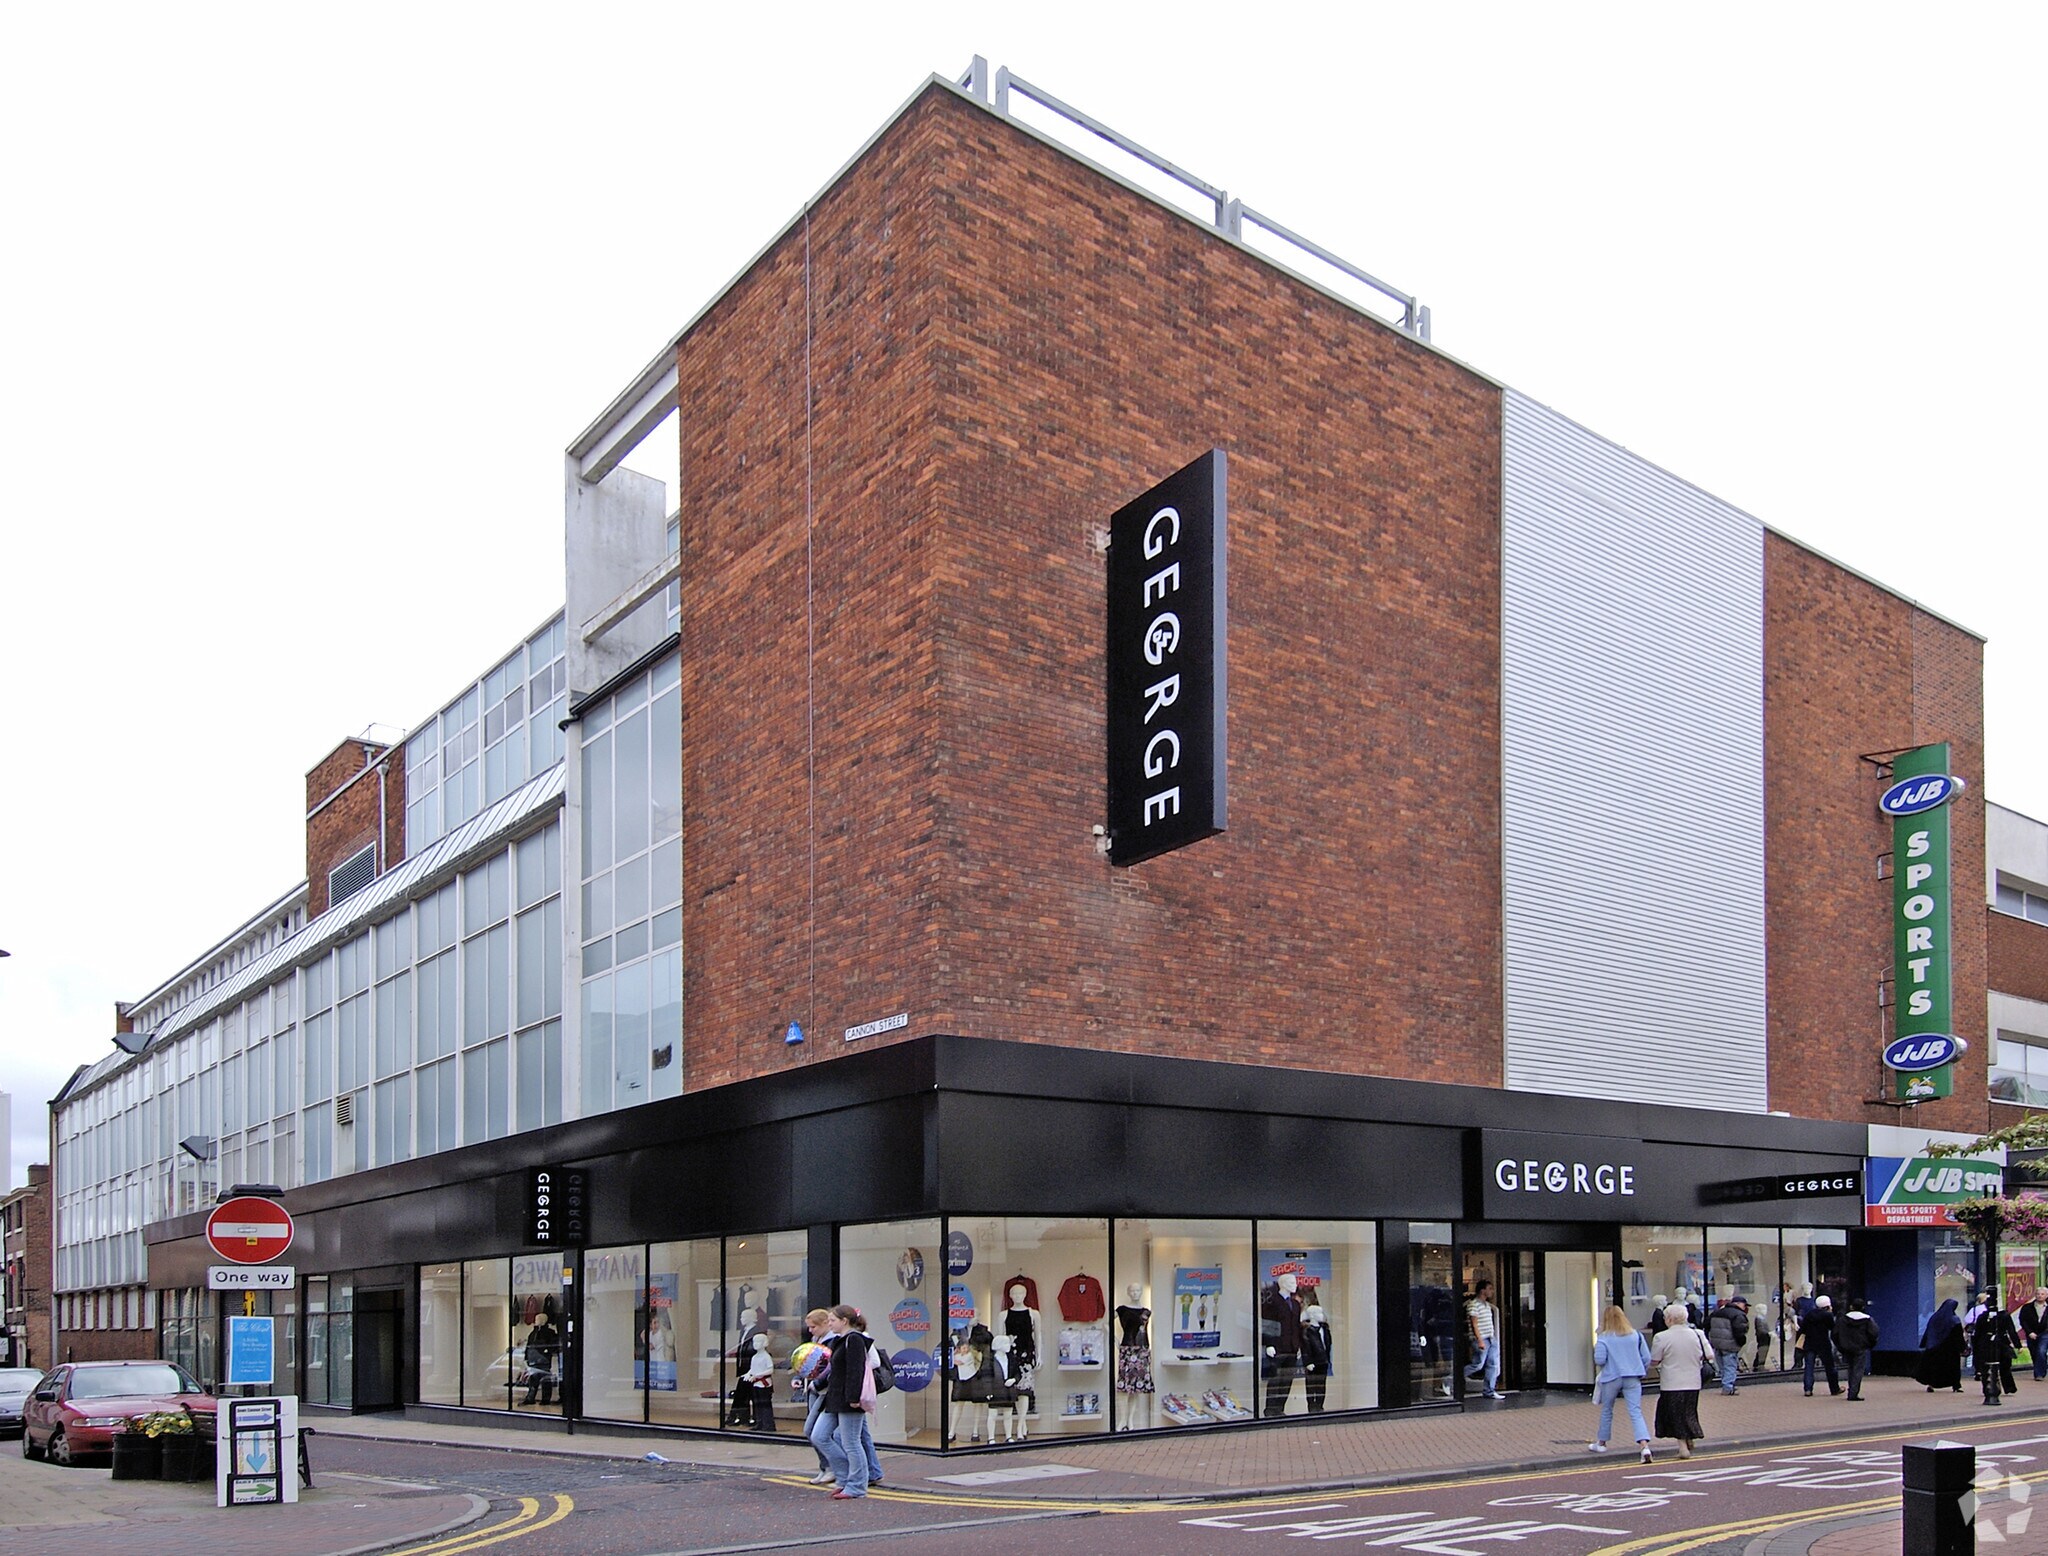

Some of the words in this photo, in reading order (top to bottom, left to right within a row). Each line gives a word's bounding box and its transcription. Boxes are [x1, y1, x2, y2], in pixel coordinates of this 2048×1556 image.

[1143, 506, 1181, 827] GEORGE
[1889, 779, 1945, 809] JJB
[1903, 831, 1935, 1016] SPORTS
[846, 1022, 876, 1039] CANNON
[879, 1014, 906, 1031] STREET
[1892, 1039, 1947, 1064] JJB
[1495, 1159, 1635, 1195] GEORGE
[1903, 1168, 1963, 1193] JJB
[1784, 1178, 1854, 1192] GEORGE
[537, 1172, 550, 1240] GEORGE
[1881, 1206, 1908, 1215] LADIES
[1910, 1206, 1937, 1215] SPORTS
[1886, 1215, 1934, 1224] DEPARTMENT
[948, 1258, 967, 1269] prima
[1271, 1263, 1297, 1276] BACK
[1298, 1265, 1305, 1274] 2
[215, 1271, 249, 1283] One
[257, 1273, 289, 1285] way
[1297, 1276, 1321, 1286] HOOL
[889, 1309, 914, 1323] BACK
[914, 1309, 921, 1320] 2
[949, 1309, 974, 1318] CHOOL
[896, 1323, 930, 1331] SCHOOL
[892, 1361, 930, 1370] available
[906, 1370, 929, 1380] year!
[1622, 1464, 1904, 1489] AND
[1178, 1504, 1632, 1556] LANE
